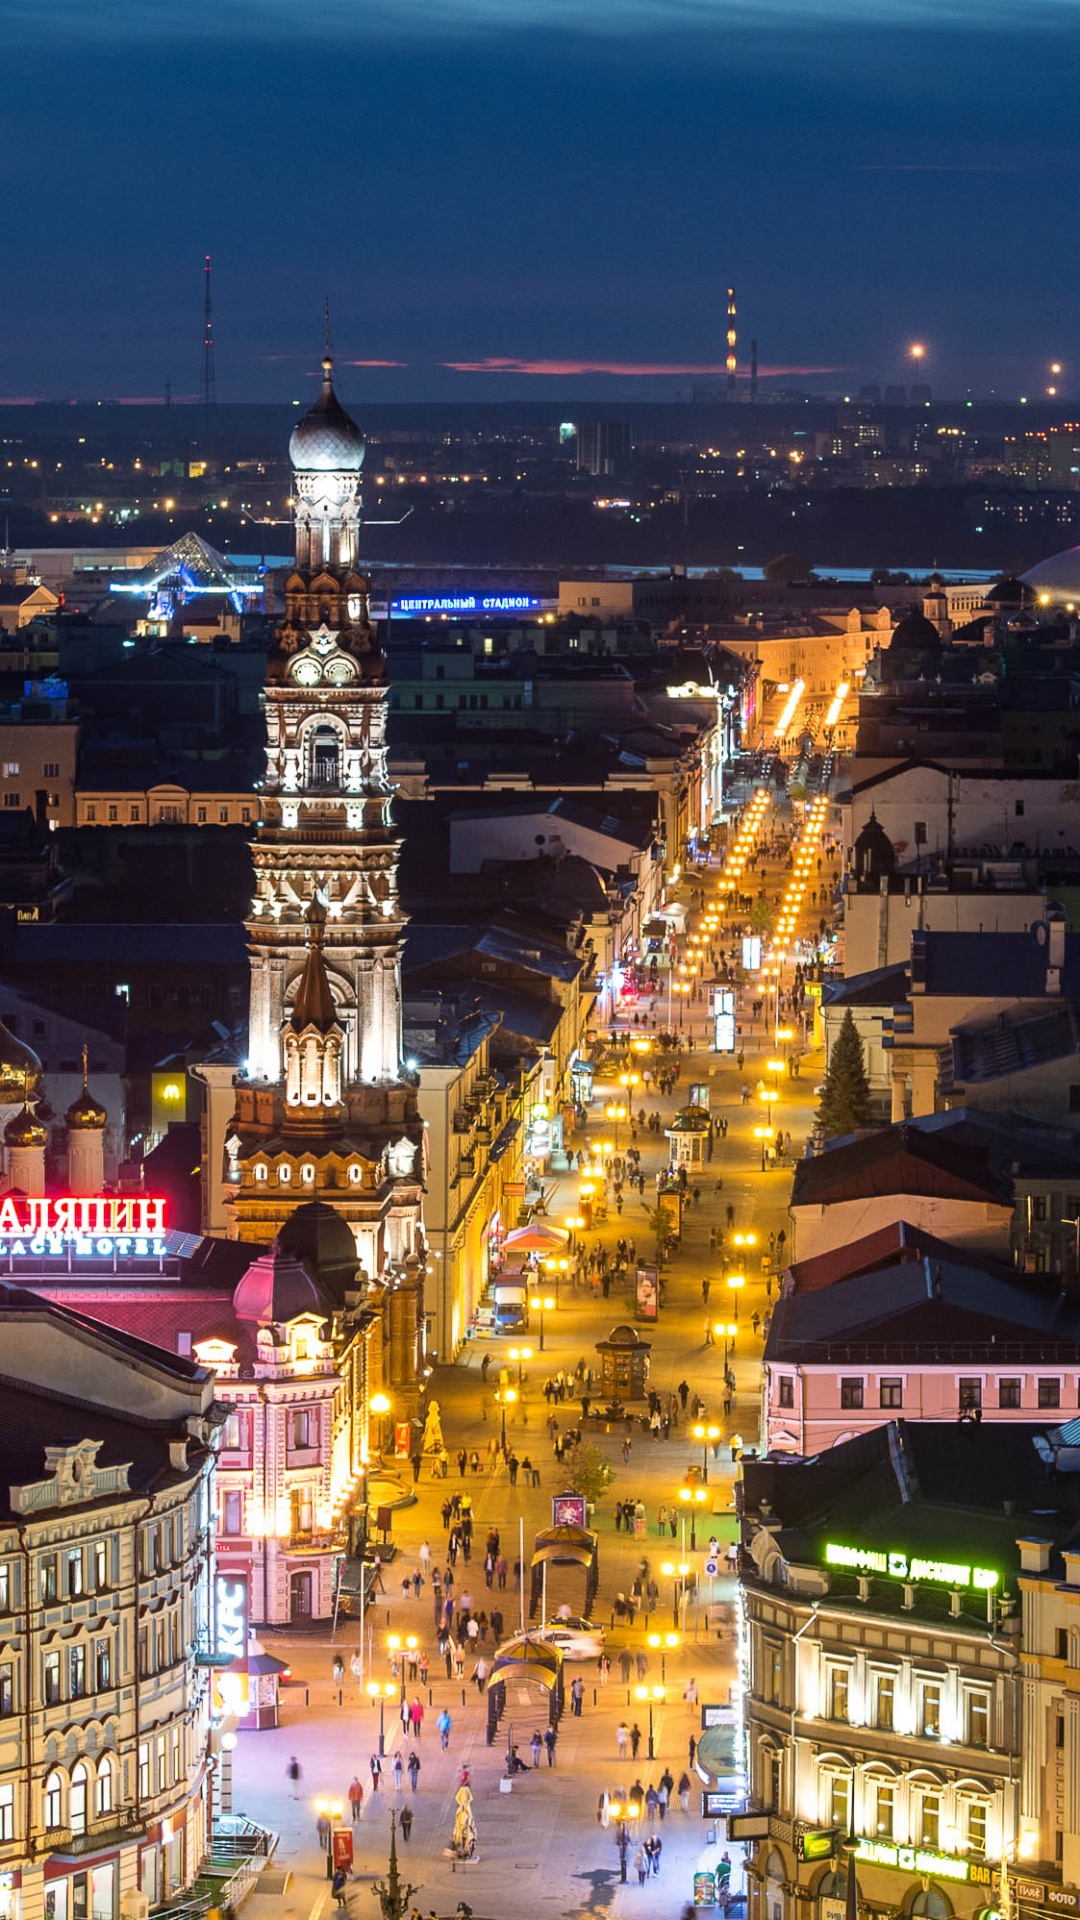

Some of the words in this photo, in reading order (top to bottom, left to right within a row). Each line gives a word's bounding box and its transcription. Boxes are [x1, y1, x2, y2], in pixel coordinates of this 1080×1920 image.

[400, 597, 475, 610] ЦЕНТРАЛЬНЫЙ
[483, 598, 529, 609] СТАДИОН
[76, 1238, 167, 1255] HOTEL
[217, 1577, 244, 1659] KFC
[970, 1866, 990, 1884] BAR
[1048, 1892, 1076, 1905] ФОТО
